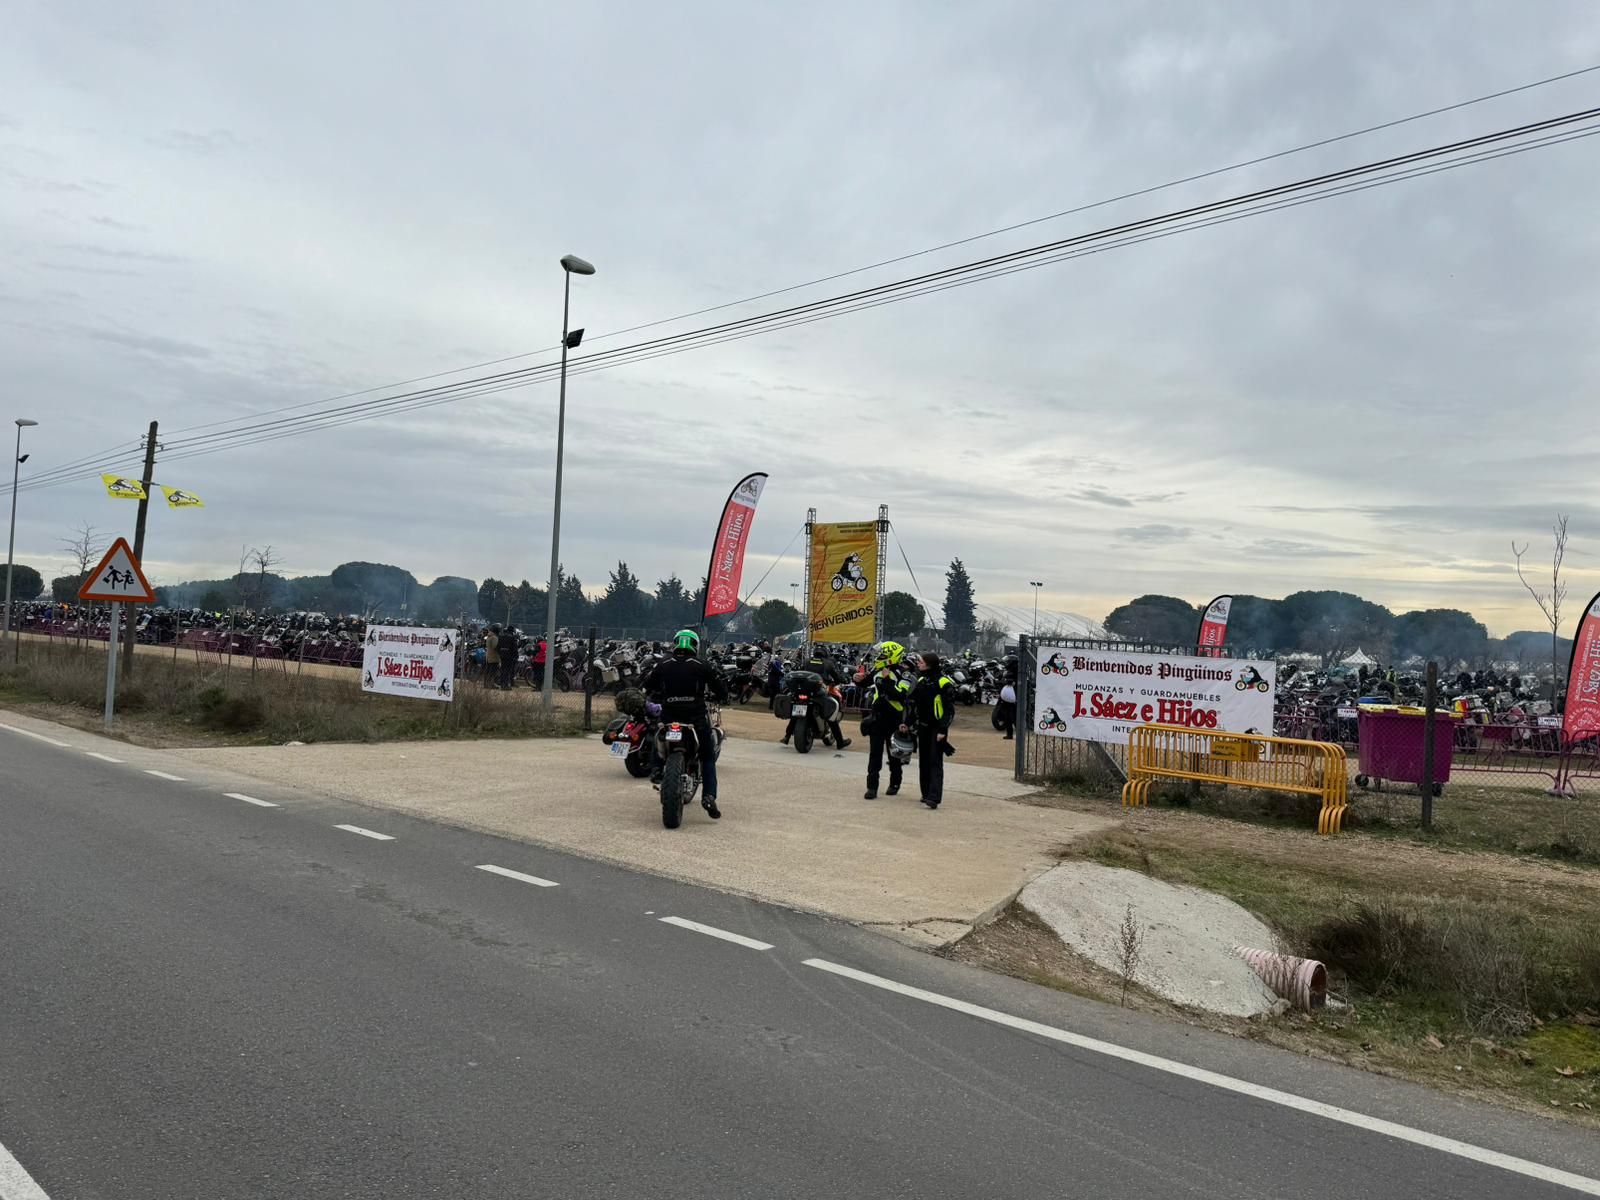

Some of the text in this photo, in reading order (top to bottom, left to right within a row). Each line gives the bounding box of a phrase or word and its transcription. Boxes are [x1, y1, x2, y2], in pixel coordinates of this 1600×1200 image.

[376, 656, 433, 684] J. Sáez e Hijos
[1072, 656, 1232, 681] Bienvenidos Pingüinos
[1076, 683, 1123, 693] MUDANZAS
[1141, 689, 1221, 701] GUARDAMUEBLES
[1072, 691, 1218, 728] J. Sáez e Hijos
